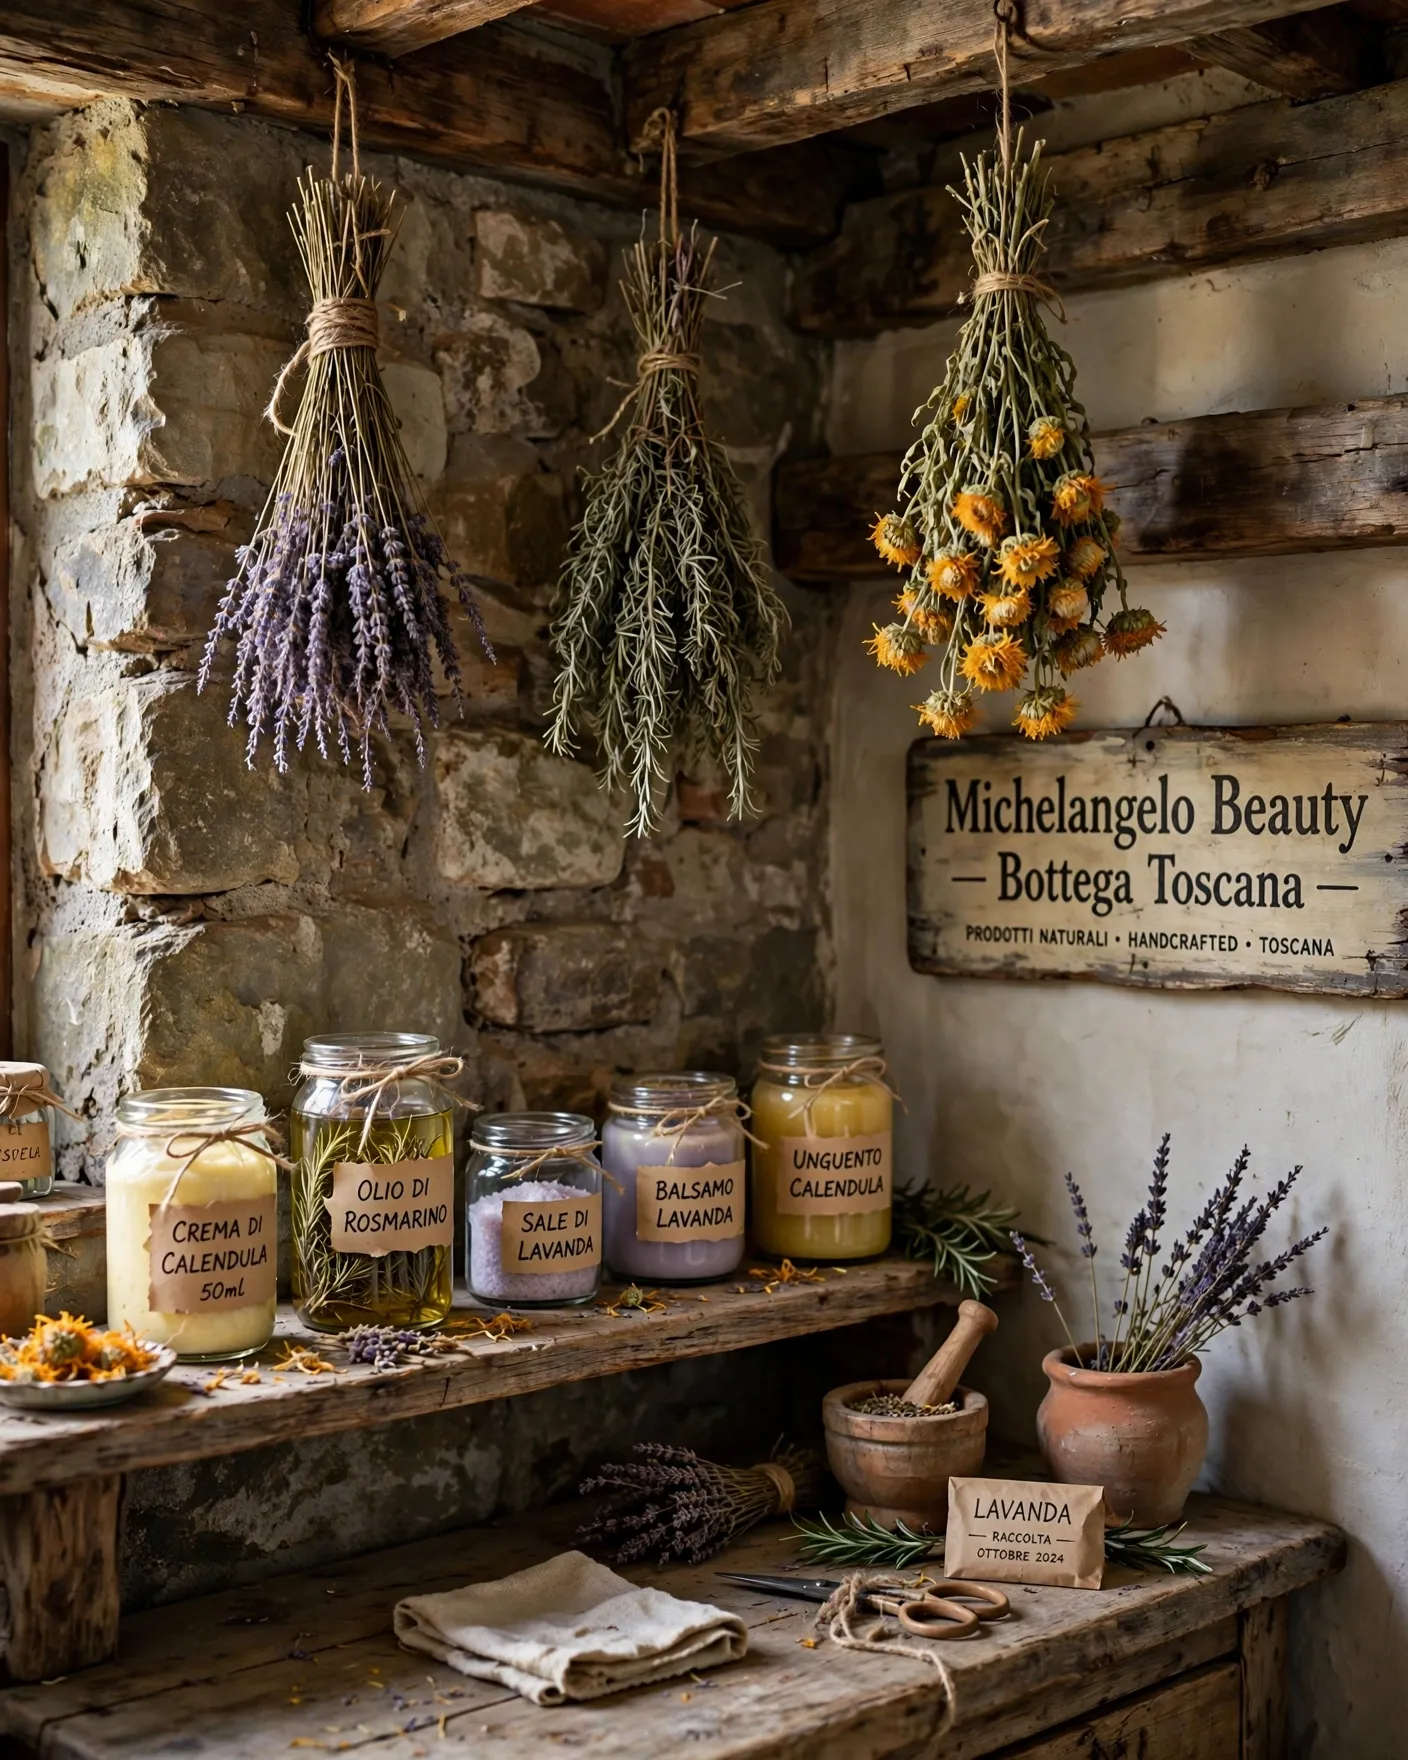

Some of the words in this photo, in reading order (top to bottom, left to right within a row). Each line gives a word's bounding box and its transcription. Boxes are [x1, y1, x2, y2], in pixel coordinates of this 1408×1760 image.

[945, 774, 1195, 850] Michelangelo
[1211, 774, 1368, 854] Beauty
[998, 851, 1133, 917] Bottega
[1147, 854, 1305, 908] Toscana
[966, 925, 1034, 944] PRODOTTI
[1039, 930, 1108, 948] NATURALI
[1128, 932, 1238, 952] HANDCRAFTED
[1259, 936, 1334, 956] TOSCANA
[793, 1147, 882, 1171] UNGUENTO
[358, 1180, 404, 1202] OLIO
[412, 1177, 430, 1198] DI
[656, 1178, 734, 1200] BALSAMO
[789, 1174, 884, 1198] CALENDULA
[172, 1219, 240, 1243] CREMA
[248, 1215, 263, 1235] DI
[344, 1204, 448, 1233] ROSMARINO
[521, 1212, 567, 1233] SALE
[574, 1211, 589, 1228] DI
[656, 1206, 734, 1228] LAVANDA
[161, 1244, 268, 1275] CALENDULA
[517, 1234, 595, 1262] LAVANDA
[199, 1278, 245, 1301] 50ml
[974, 1498, 1071, 1525] LAVANDA
[992, 1531, 1052, 1544] RACCOLTA
[977, 1547, 1030, 1562] OTTOBRE
[1035, 1552, 1065, 1563] 2024
